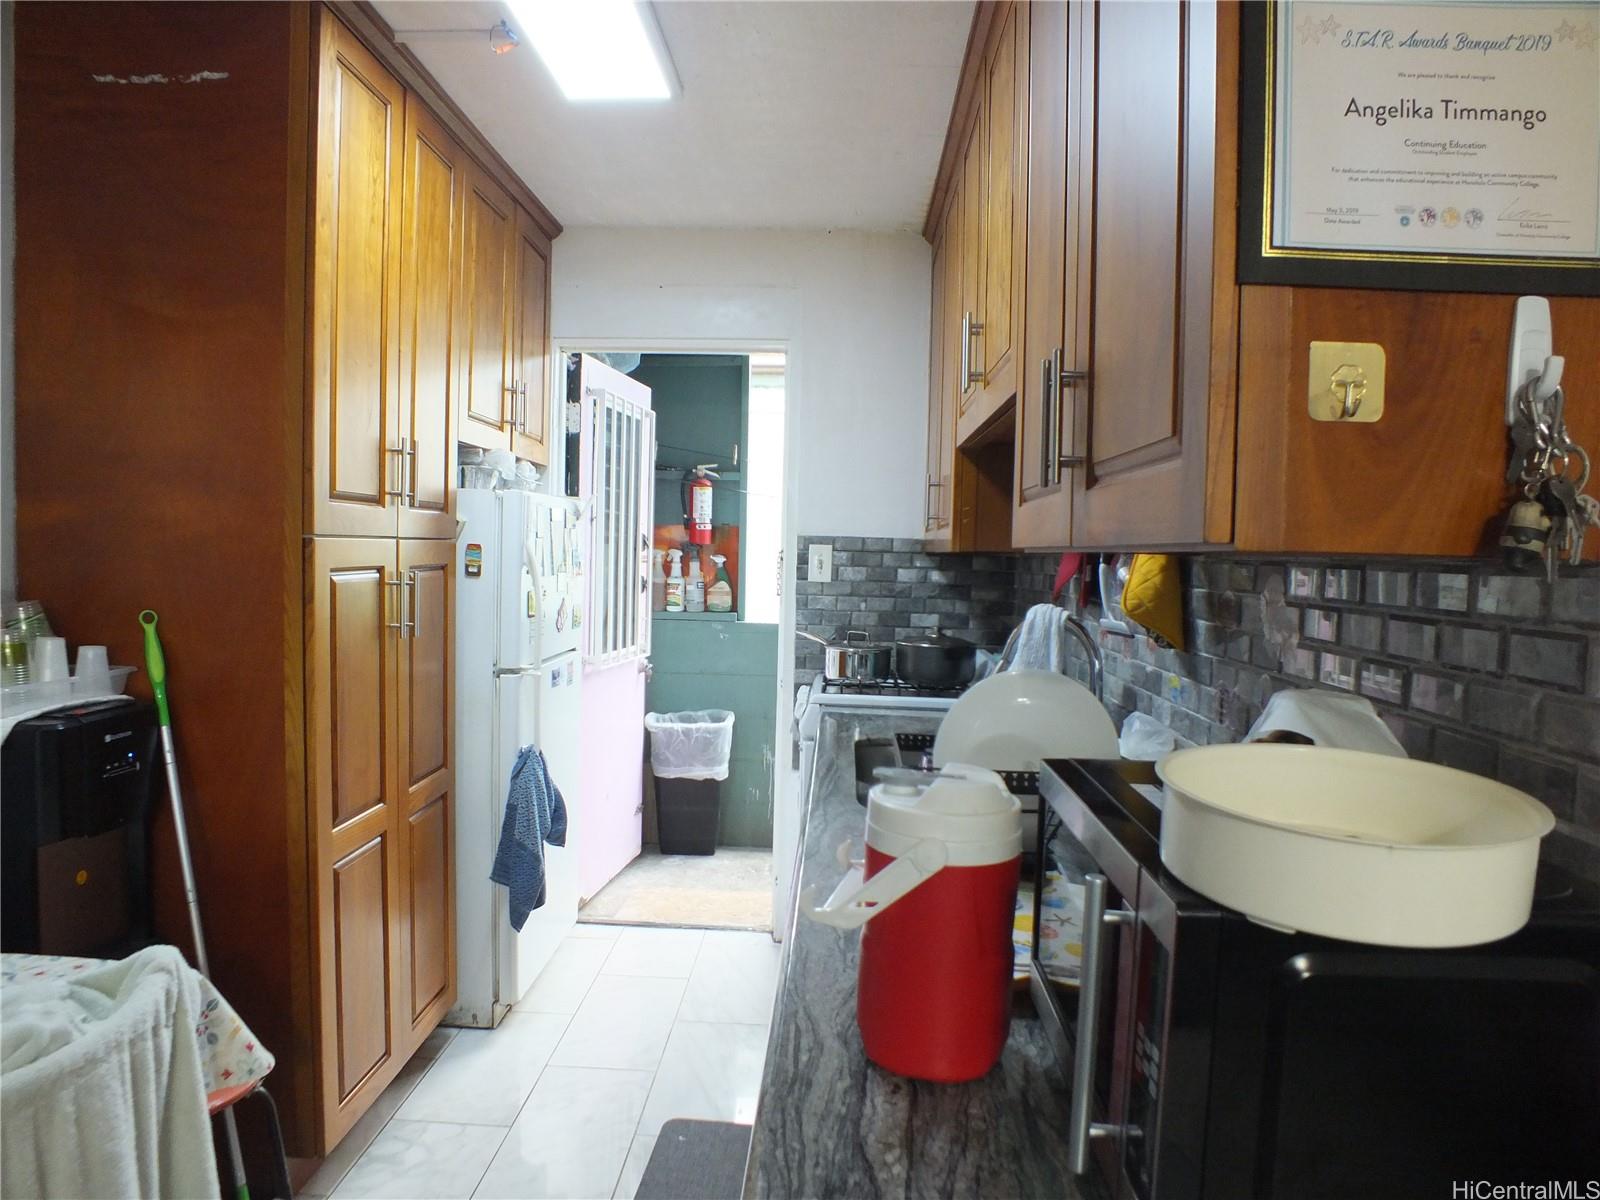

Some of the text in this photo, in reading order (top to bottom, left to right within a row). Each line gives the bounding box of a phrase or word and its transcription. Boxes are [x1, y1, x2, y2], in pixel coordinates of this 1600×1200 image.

[1399, 28, 1449, 50] Awards
[1452, 32, 1517, 56] Banquet
[1515, 34, 1553, 52] 2019
[1343, 97, 1547, 130] Angelika Timmango
[1403, 138, 1487, 151] Continuing Education
[1461, 171, 1482, 179] building
[1487, 180, 1519, 188] Community
